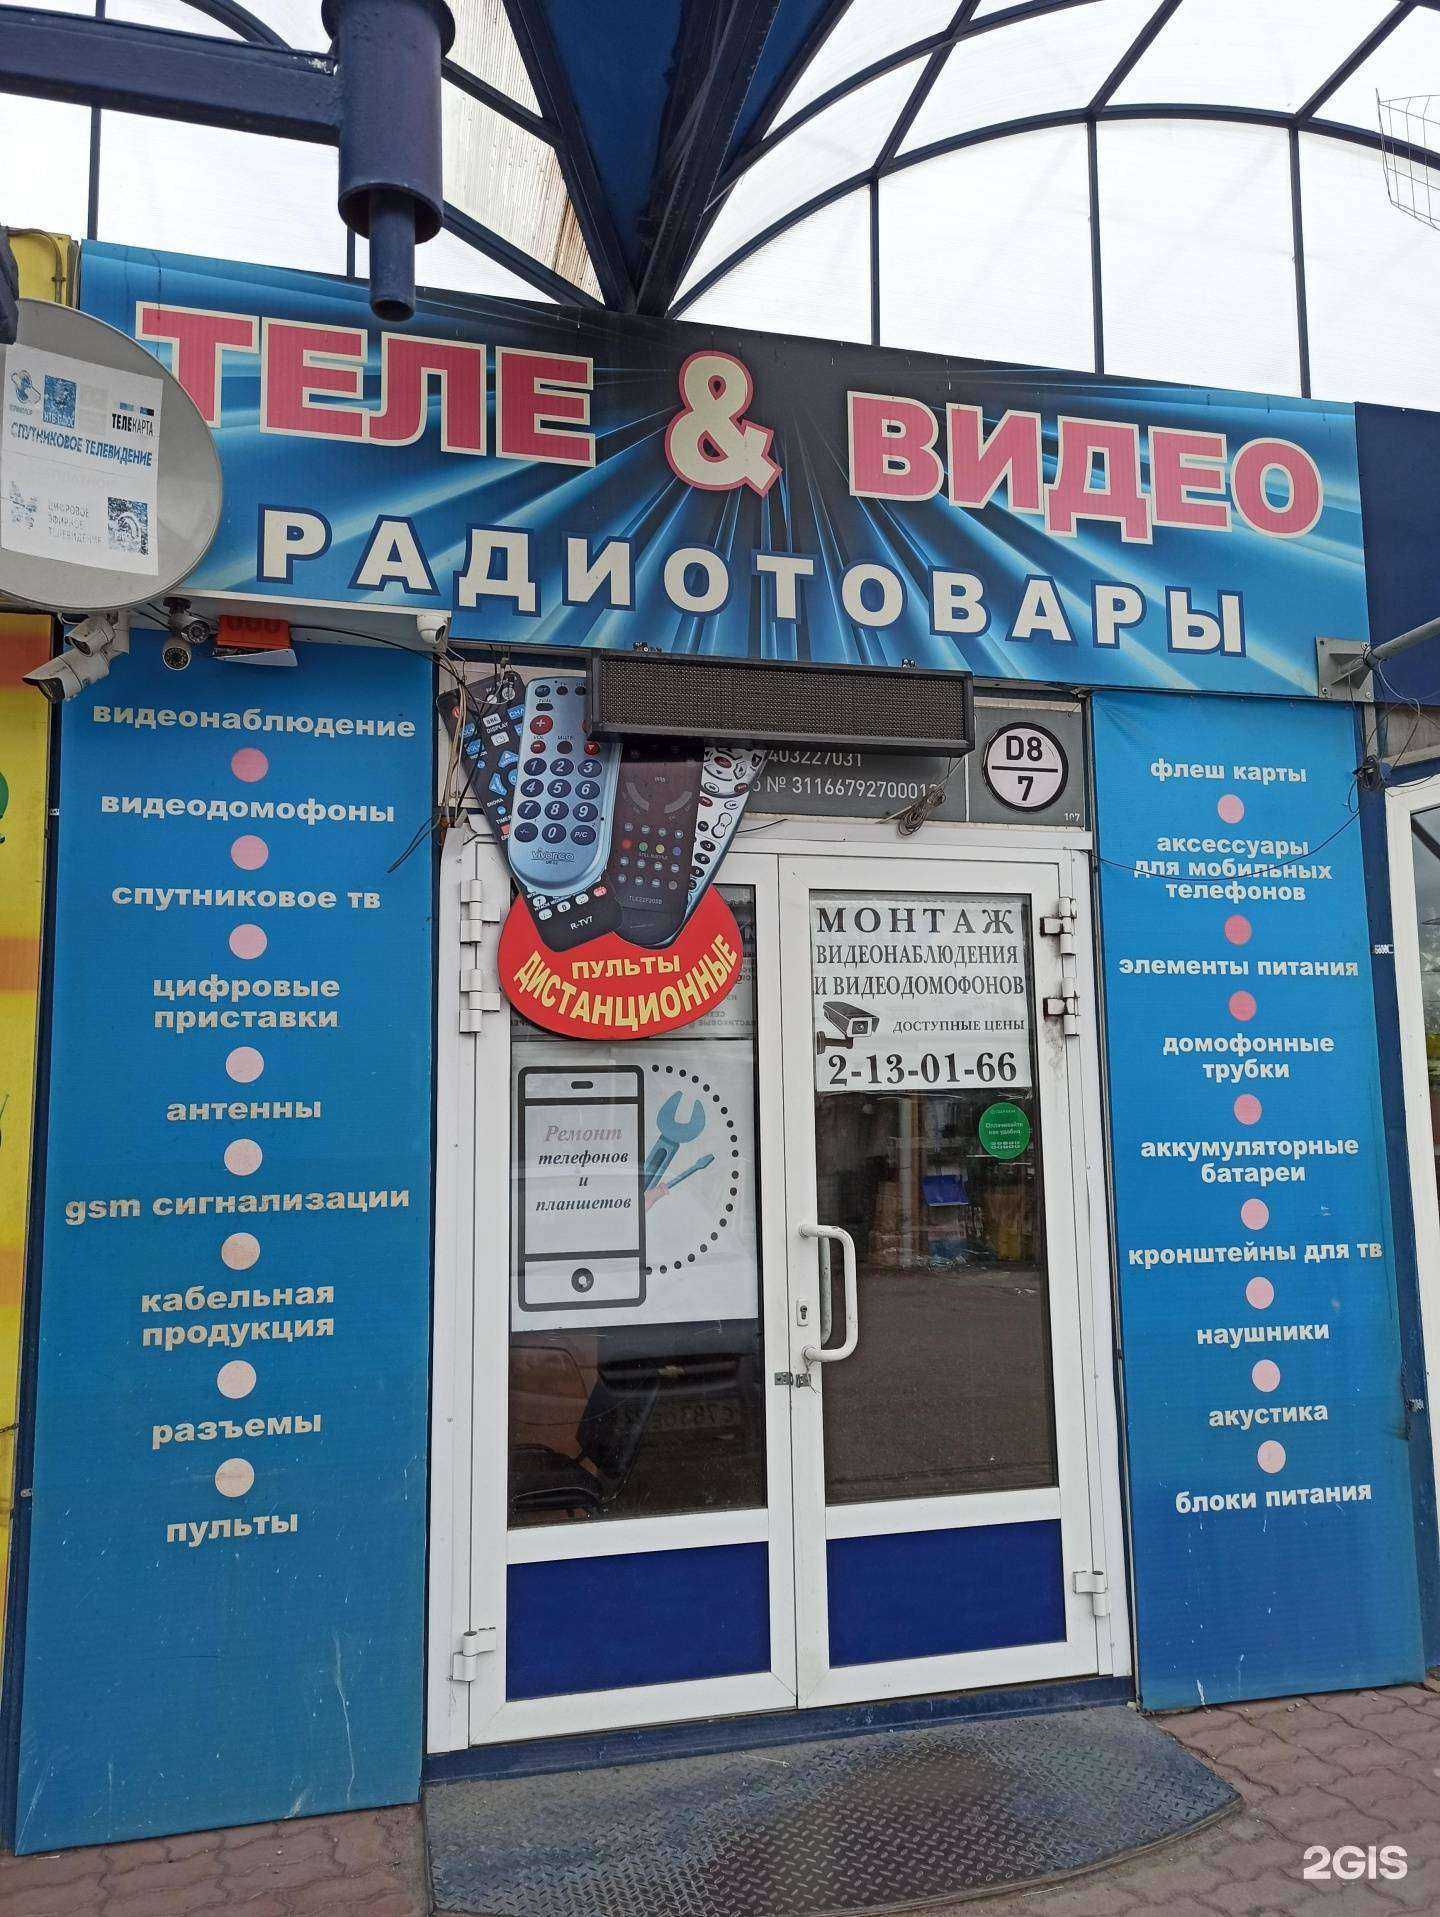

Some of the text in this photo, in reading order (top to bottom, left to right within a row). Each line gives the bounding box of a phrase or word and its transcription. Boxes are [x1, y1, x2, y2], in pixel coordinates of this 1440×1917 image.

[112, 412, 154, 437] ТЕЛЕКАРТА
[136, 301, 1324, 544] ТЕЛЕ & ВИДЕО
[85, 438, 153, 467] ТЕЛЕВИДЕНИЕ
[257, 504, 1247, 658] РАДИОТОВАРЫ
[92, 704, 416, 738] видеонаблюдение
[1005, 735, 1045, 762] D8
[530, 760, 593, 773] 1 2 3
[1150, 758, 1307, 785] флеш карты
[526, 781, 591, 795] 4 5 6
[1017, 775, 1035, 802] 7
[101, 795, 394, 825] видеодомофоны
[524, 802, 588, 818] 7 8 9
[547, 826, 557, 839] 0
[1156, 834, 1309, 859] аксессуары
[1133, 857, 1333, 880] для мобильных
[111, 886, 381, 911] спутниковое тв
[1165, 880, 1307, 904] телефонов
[570, 915, 593, 930] R-TV7
[816, 907, 1014, 934] МОНТАЖ
[571, 954, 681, 980] ПУЛЬТЫ
[815, 944, 1019, 968] ВИДЕОНАБЛЮДЕНИЯ
[1118, 957, 1359, 977] элементы питания
[152, 973, 341, 1003] цифровые
[513, 934, 738, 1032] ДИСТАНЦИОННЫЕ
[814, 975, 1025, 1000] И ВИДЕОДОМОФОНОВ
[153, 1008, 339, 1034] приставки
[892, 1019, 1025, 1033] ДОСТУПНЫЕ ЦЕНЫ
[1162, 1032, 1335, 1057] домофонные
[828, 1052, 1018, 1087] 2-13-01-66
[1202, 1058, 1291, 1083] трубки
[166, 1100, 322, 1121] антенны
[543, 1125, 623, 1142] Ремонт
[538, 1149, 629, 1168] телефонов
[1140, 1138, 1360, 1163] аккумуляторные
[579, 1176, 589, 1187] и
[1200, 1162, 1306, 1188] батареи
[65, 1188, 410, 1226] gsm сигнализации
[535, 1198, 632, 1212] планшетов
[1128, 1240, 1384, 1270] кронштейны для тв
[141, 1284, 335, 1313] кабельная
[142, 1316, 335, 1351] продукция
[1196, 1322, 1330, 1349] наушники
[1208, 1404, 1329, 1430] акустика
[152, 1413, 322, 1450] разъемы
[1174, 1483, 1373, 1514] блоки питания
[166, 1513, 299, 1548] пульты
